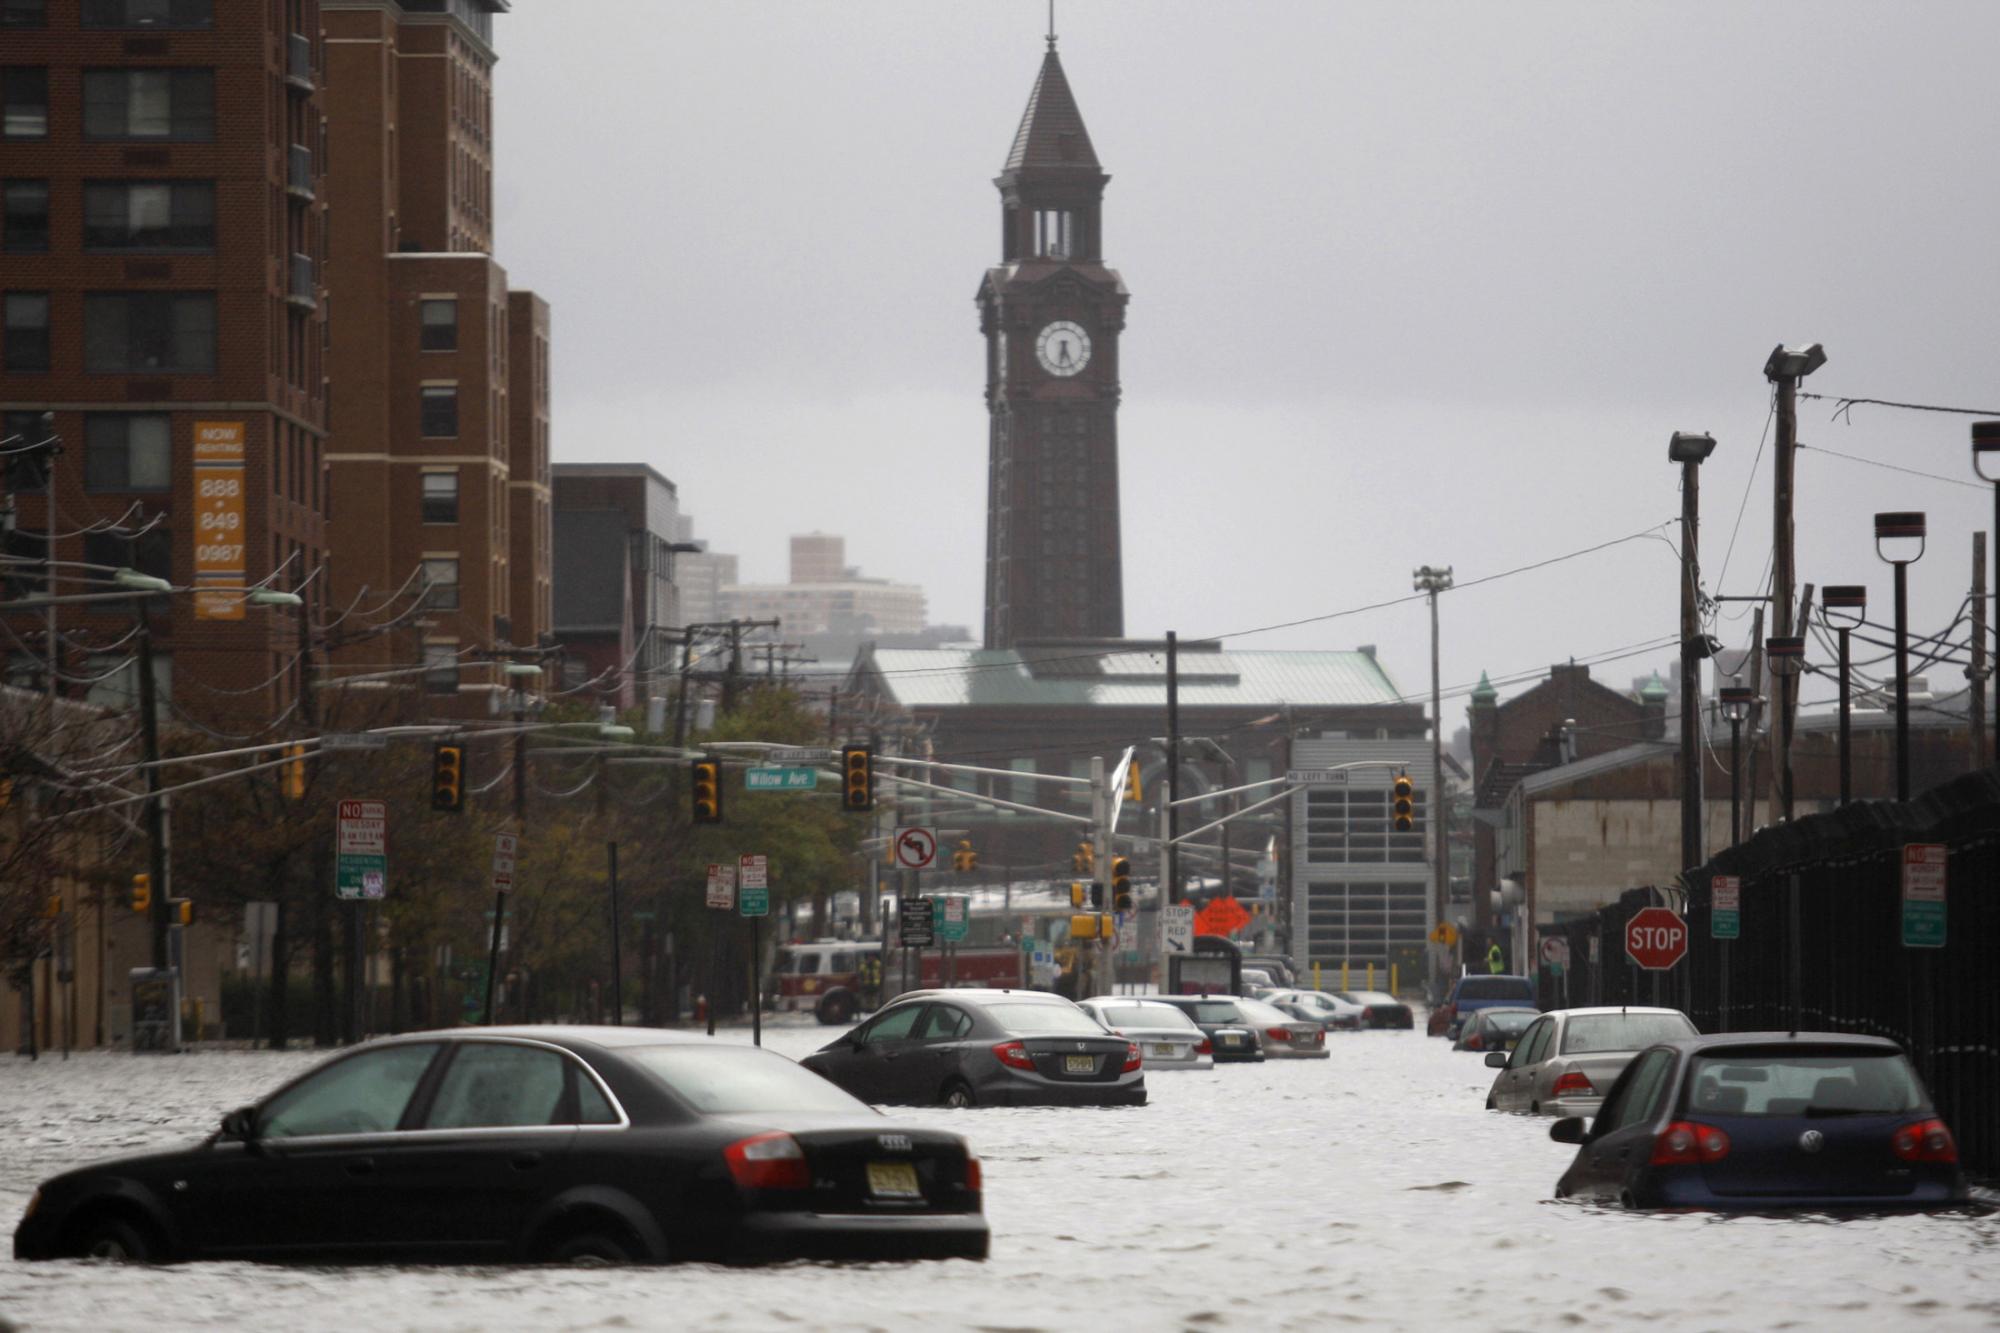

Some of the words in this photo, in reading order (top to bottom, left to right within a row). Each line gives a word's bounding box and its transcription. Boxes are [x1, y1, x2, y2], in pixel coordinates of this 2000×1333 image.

[202, 428, 237, 440] NOW
[200, 479, 240, 497] 888
[201, 512, 240, 529] 849
[197, 545, 243, 561] 0987
[750, 772, 782, 785] Willow
[342, 803, 360, 818] NO
[1166, 908, 1191, 918] STOP
[1168, 927, 1186, 936] RED
[1631, 926, 1682, 950] STOP
